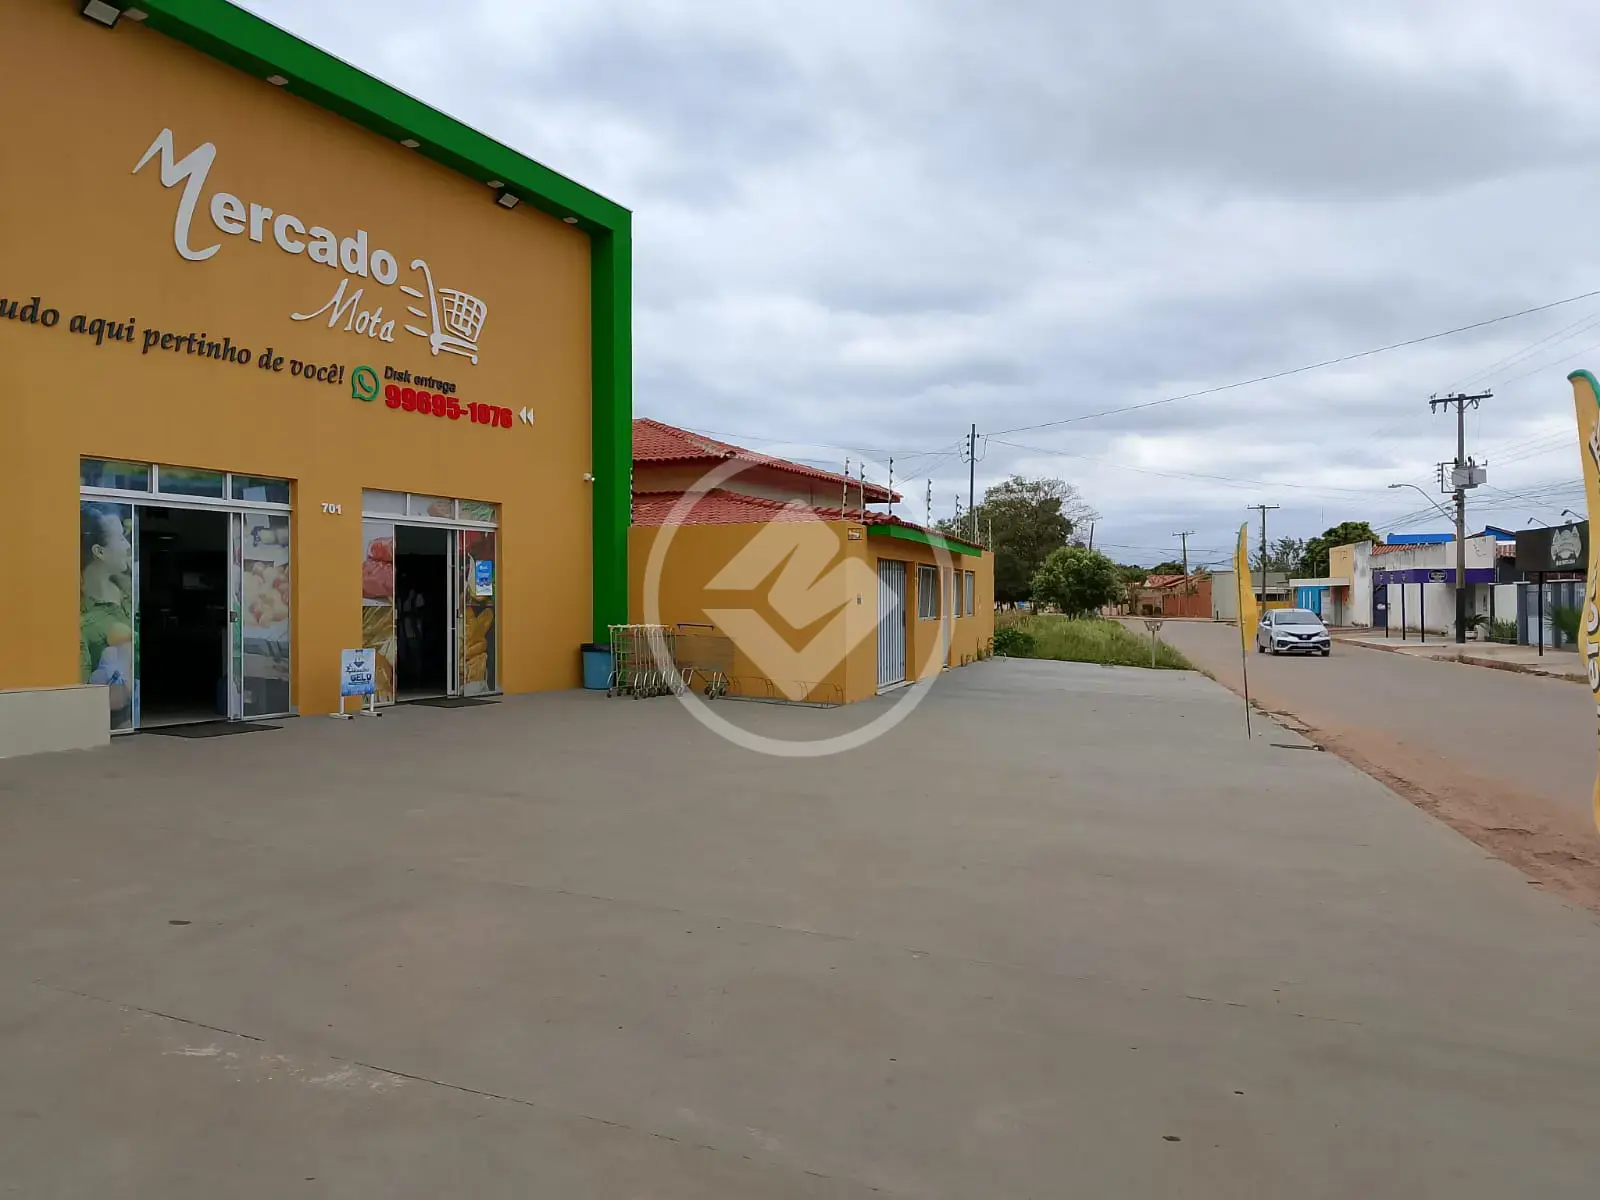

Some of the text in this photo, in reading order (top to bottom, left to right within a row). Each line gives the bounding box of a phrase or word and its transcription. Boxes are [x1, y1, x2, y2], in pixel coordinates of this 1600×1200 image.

[131, 127, 399, 286] Mercado
[289, 278, 396, 344] Mota
[69, 315, 136, 346] aqui
[142, 328, 252, 365] pertinho
[257, 347, 285, 372] de
[289, 359, 345, 385] você!
[384, 384, 513, 429] 99695-1076
[413, 374, 457, 394] entrega
[321, 502, 342, 515] 701
